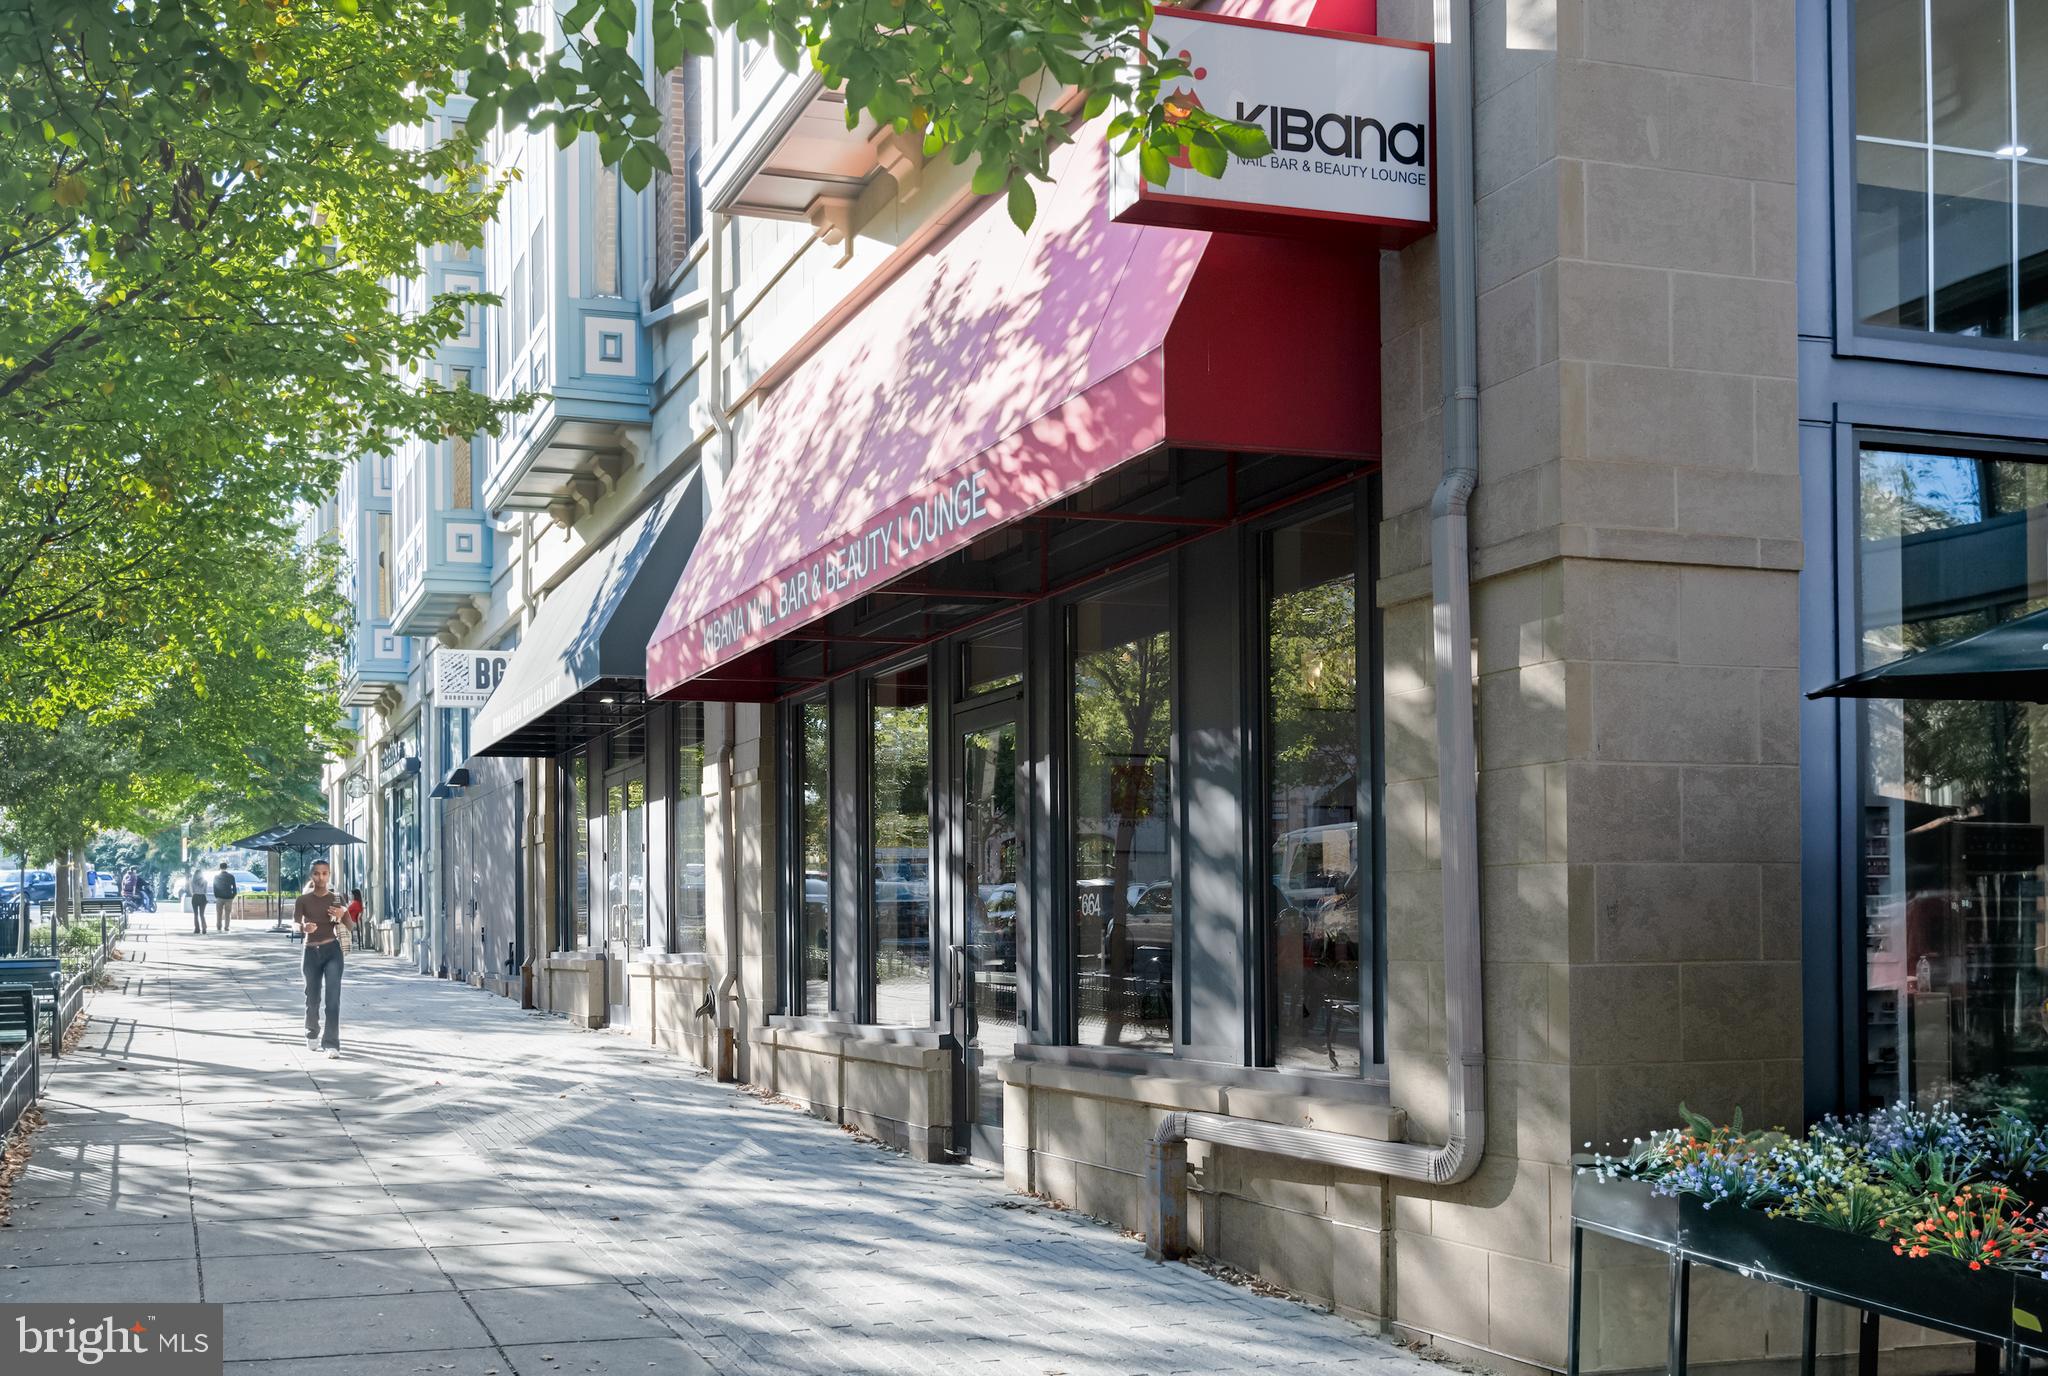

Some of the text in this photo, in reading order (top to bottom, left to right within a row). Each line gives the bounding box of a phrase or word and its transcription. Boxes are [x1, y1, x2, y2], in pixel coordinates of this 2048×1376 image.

[1271, 156, 1298, 171] BAR
[1302, 159, 1311, 172] &
[1315, 161, 1367, 178] BEAUTY
[1371, 168, 1426, 186] LOUNGE
[703, 468, 987, 653] KIBANA NAIL BAR & BEAUTY LOUNGE
[475, 657, 508, 690] BG
